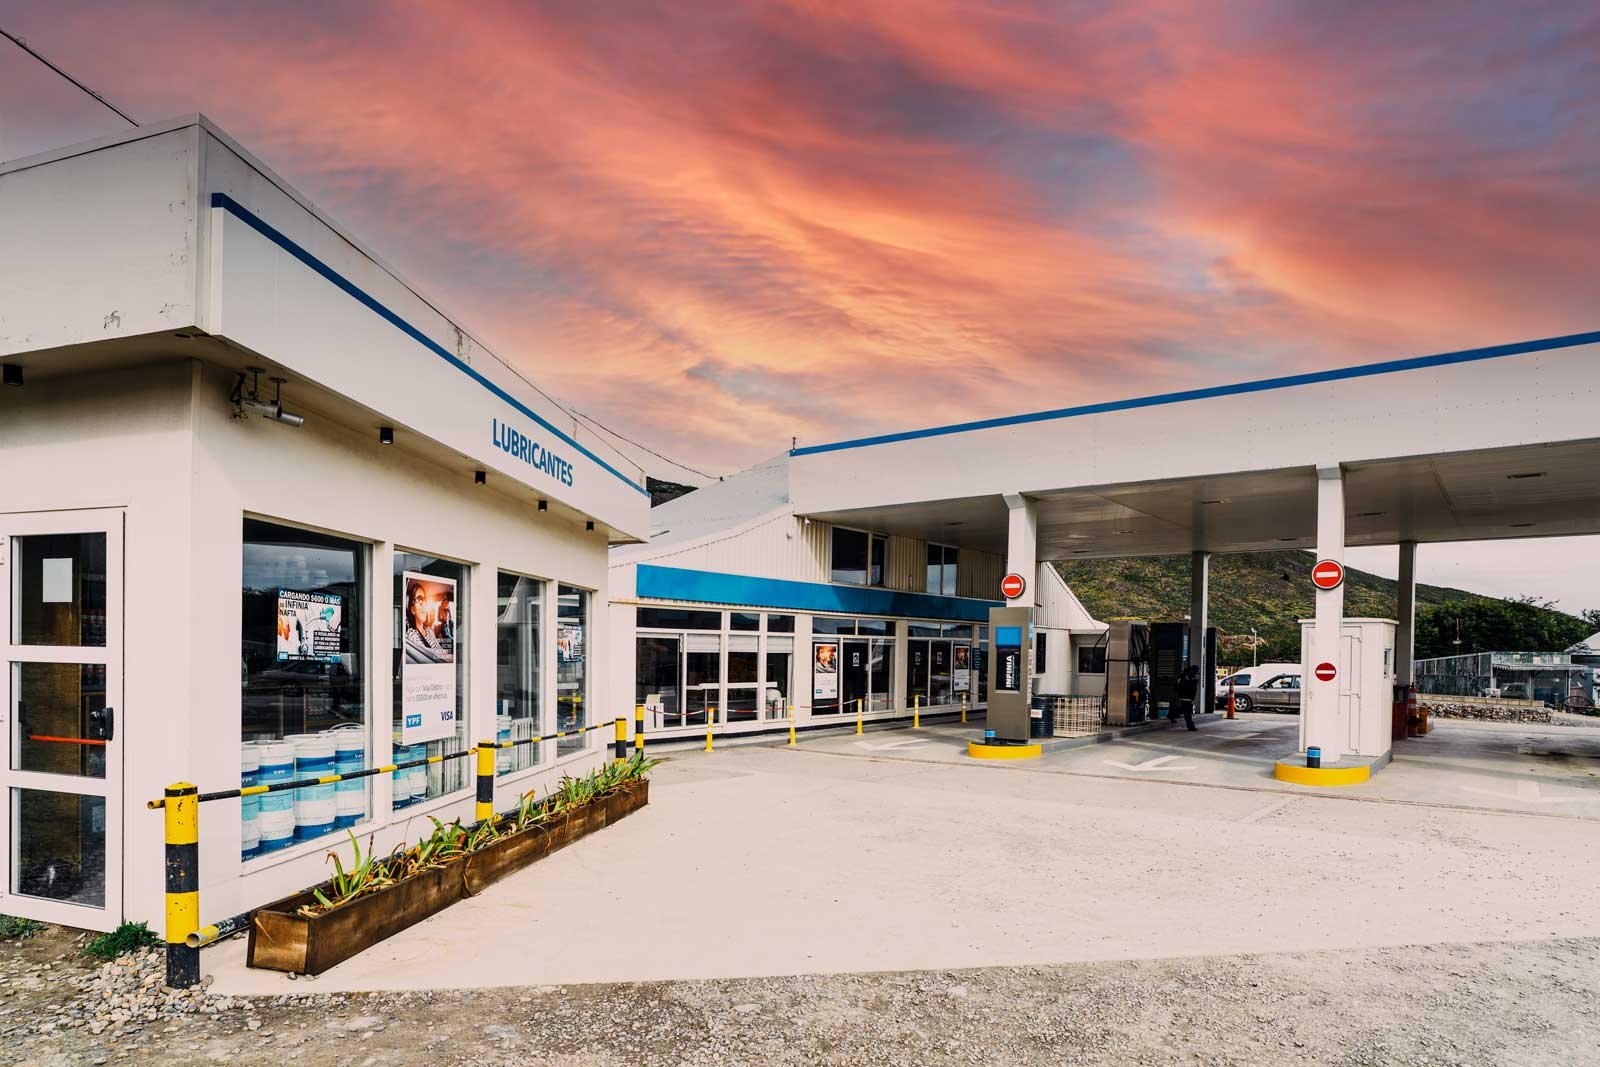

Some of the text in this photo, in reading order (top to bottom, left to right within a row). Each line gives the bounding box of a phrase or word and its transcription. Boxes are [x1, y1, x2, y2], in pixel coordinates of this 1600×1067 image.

[493, 418, 573, 487] LUBRICANTES
[280, 591, 310, 601] CARGANDO
[285, 600, 309, 610] INFINIA
[280, 609, 297, 617] NAFTA
[440, 711, 454, 721] VISA
[407, 717, 421, 726] YPF
